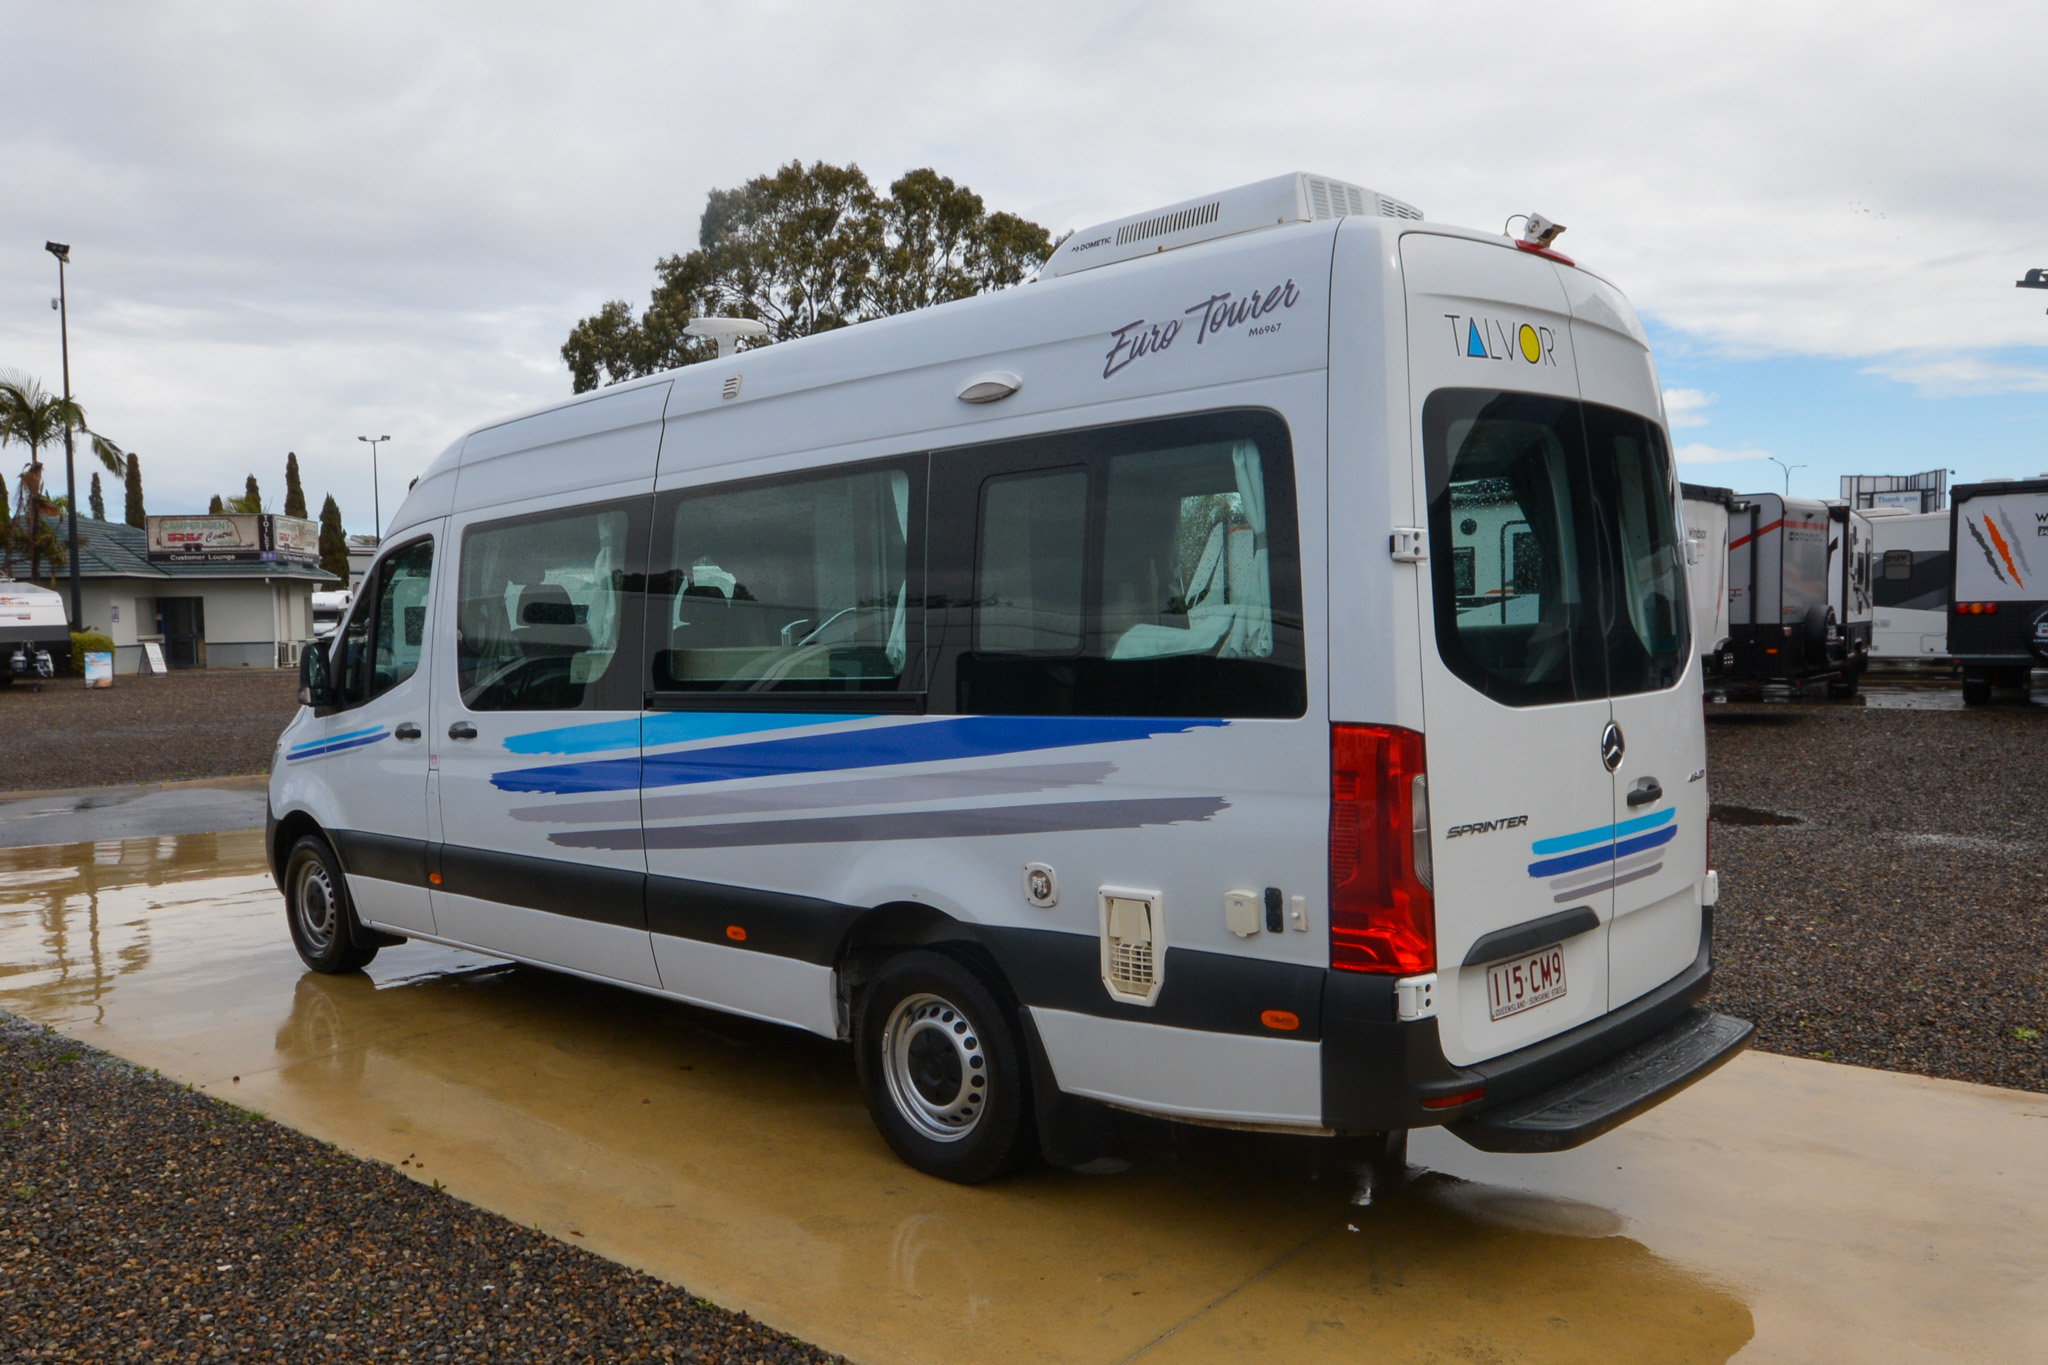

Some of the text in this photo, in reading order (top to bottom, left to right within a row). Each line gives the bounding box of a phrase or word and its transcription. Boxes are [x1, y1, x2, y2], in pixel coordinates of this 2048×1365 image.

[1080, 236, 1112, 251] DOMETIC
[1103, 278, 1300, 379] Euro Tourer
[1248, 322, 1282, 337] M6967
[1444, 314, 1557, 367] TALVOR
[1877, 495, 1900, 503] Thank
[167, 530, 232, 543] RV Centre
[1446, 814, 1529, 840] SPRINTER
[1495, 985, 1563, 1017] QUEENSLAND SUNSHINE STATE
